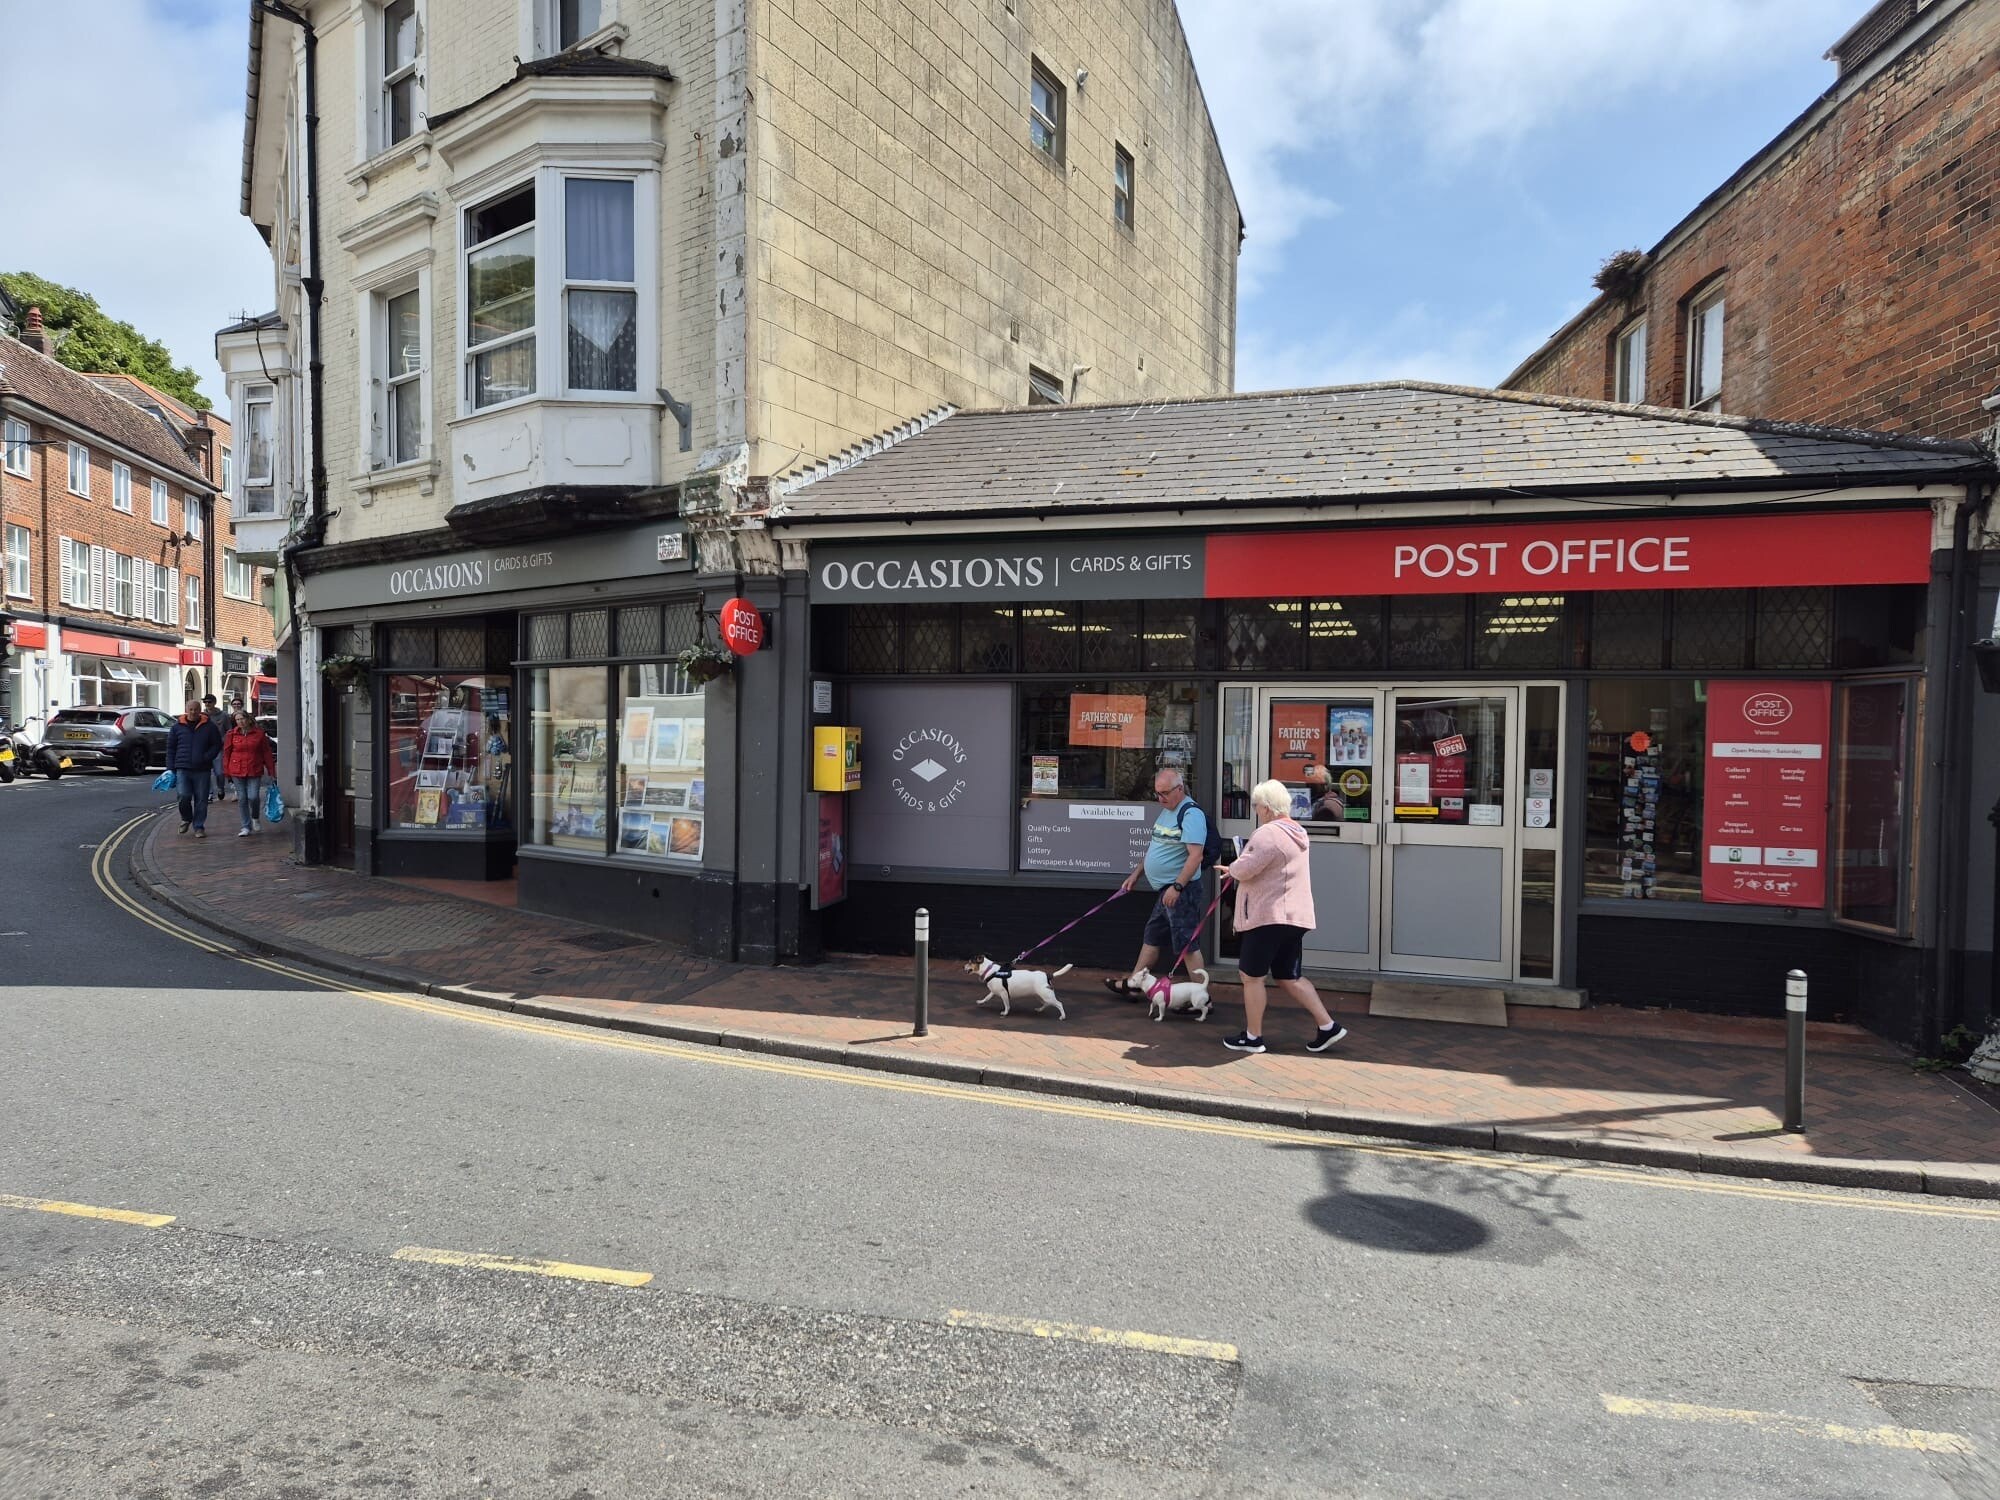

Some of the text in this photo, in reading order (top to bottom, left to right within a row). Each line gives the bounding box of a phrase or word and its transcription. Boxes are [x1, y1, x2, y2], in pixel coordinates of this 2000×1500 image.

[1394, 537, 1690, 578] POST OFFICE
[390, 552, 553, 595] OCCASIONS CARDS & GIFTS
[821, 555, 1192, 590] OCCASIONS CARDS & GIFTS
[733, 609, 756, 626] POST
[728, 624, 758, 643] OFFICE
[1755, 700, 1783, 708] POST
[1081, 711, 1134, 724] FATHER'S DAY
[1749, 708, 1785, 717] OFFICE
[1278, 727, 1320, 739] FATHER'S
[892, 728, 967, 763] OCCASIONS
[1290, 740, 1308, 751] DAY
[1439, 742, 1463, 756] OPEN
[892, 778, 966, 812] CARDS & GIFTS
[1081, 807, 1135, 817] Available here
[1027, 824, 1071, 834] Quality Cards
[1129, 827, 1153, 835] Gift Wr
[1027, 835, 1043, 843] Gifts
[1027, 847, 1051, 856] Lottery
[1027, 858, 1068, 867] Newspapers
[1075, 859, 1111, 868] Magazines
